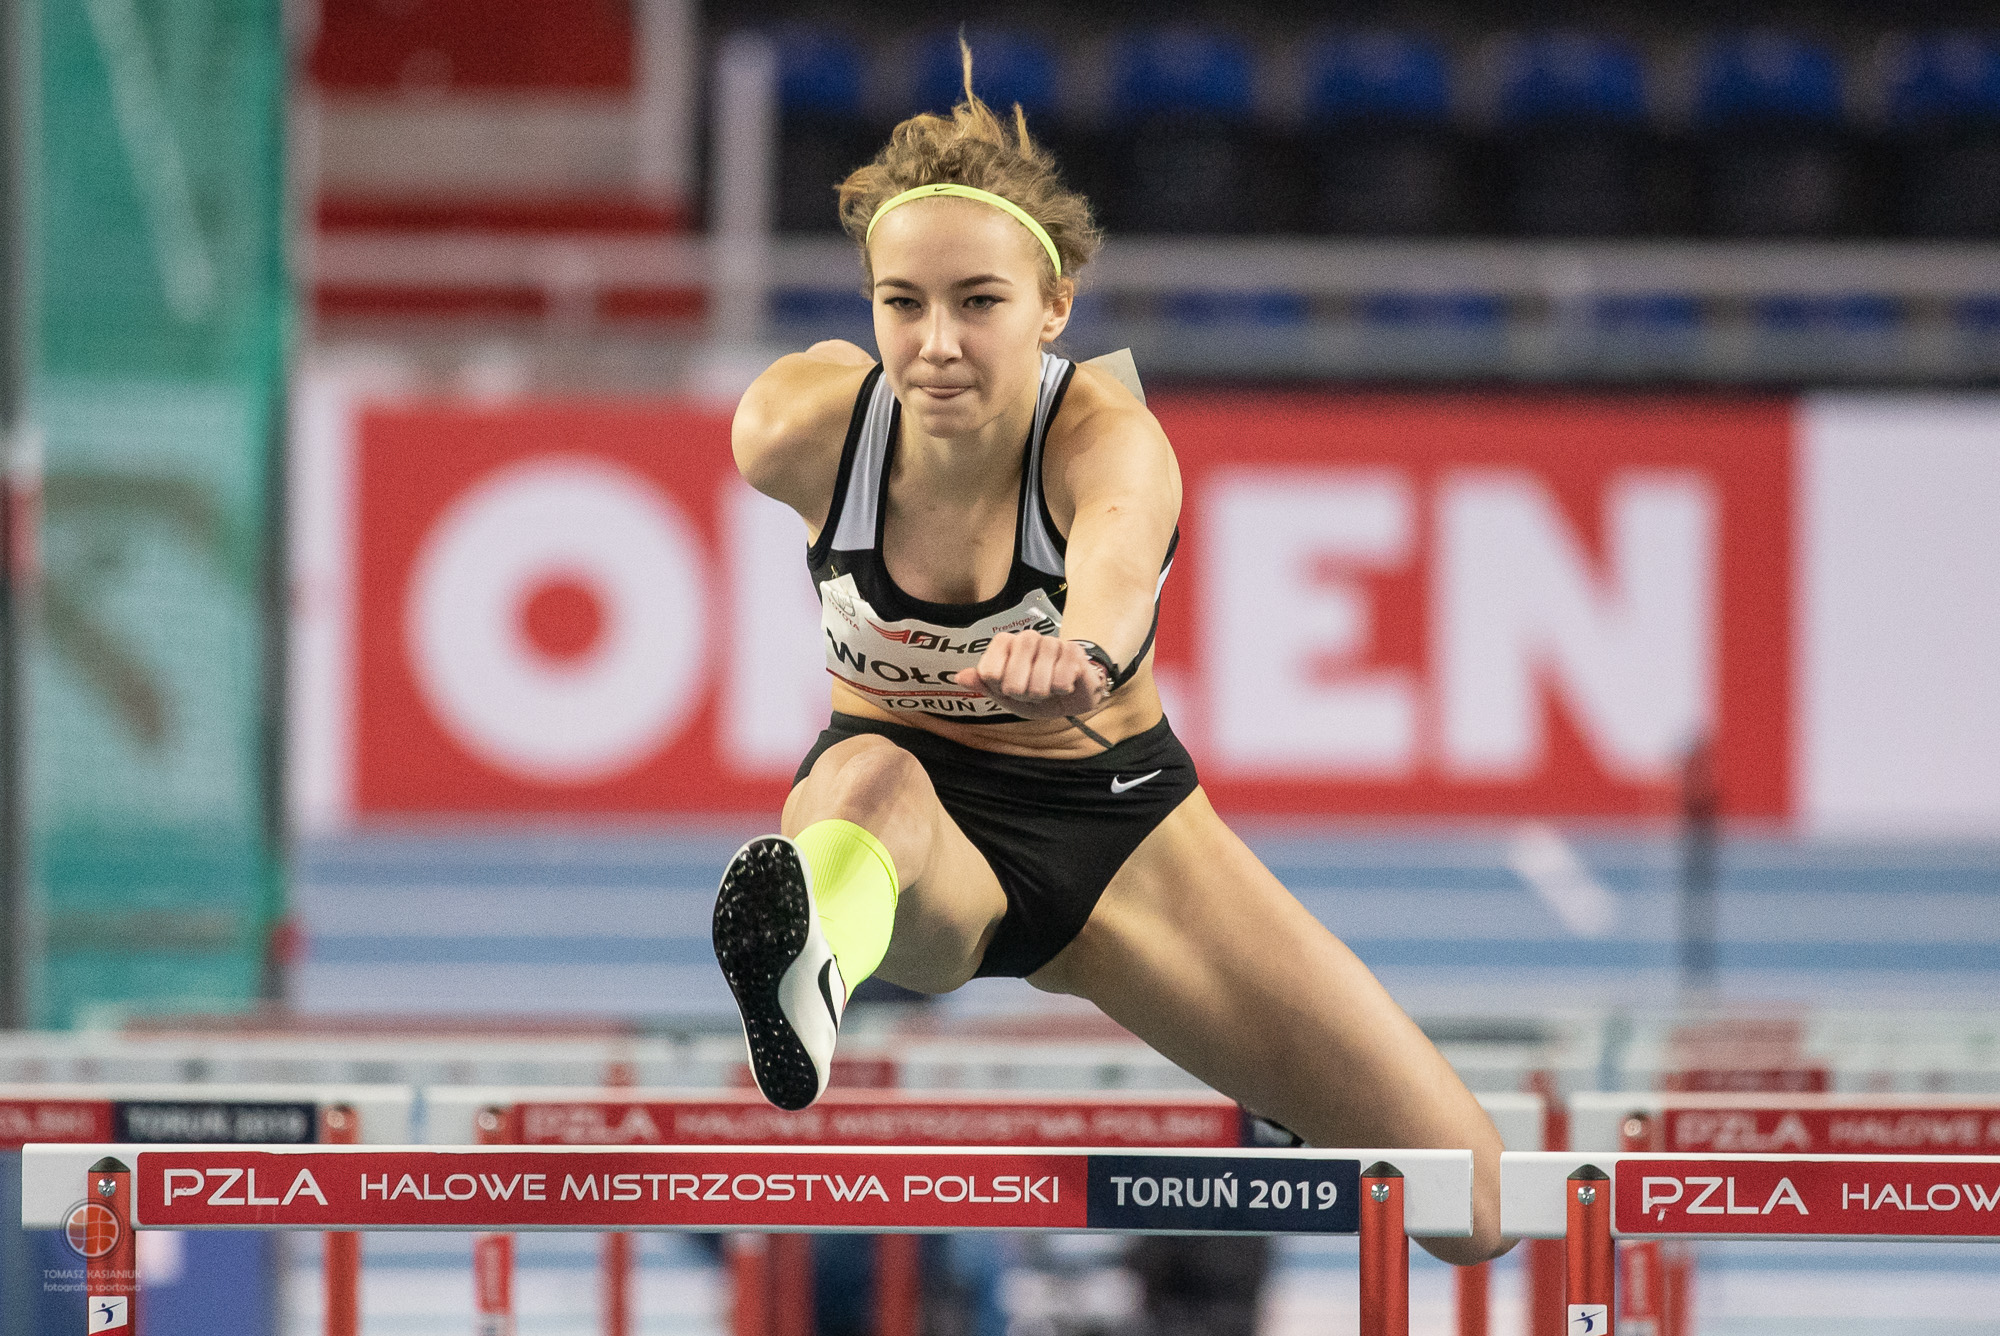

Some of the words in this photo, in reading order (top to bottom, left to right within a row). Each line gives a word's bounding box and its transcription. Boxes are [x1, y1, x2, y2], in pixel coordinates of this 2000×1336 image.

[406, 454, 1719, 784] OEN
[881, 697, 977, 712] TORUŃ
[164, 1168, 328, 1206] PZLA
[360, 1173, 546, 1201] HALOWE
[561, 1173, 890, 1202] MISTRZOSTWA
[903, 1175, 1059, 1203] POLSKI
[1111, 1172, 1238, 1208] TORUŃ
[1248, 1179, 1338, 1210] 2019
[1642, 1176, 1809, 1216] PZLA
[1842, 1183, 2000, 1211] HALOW
